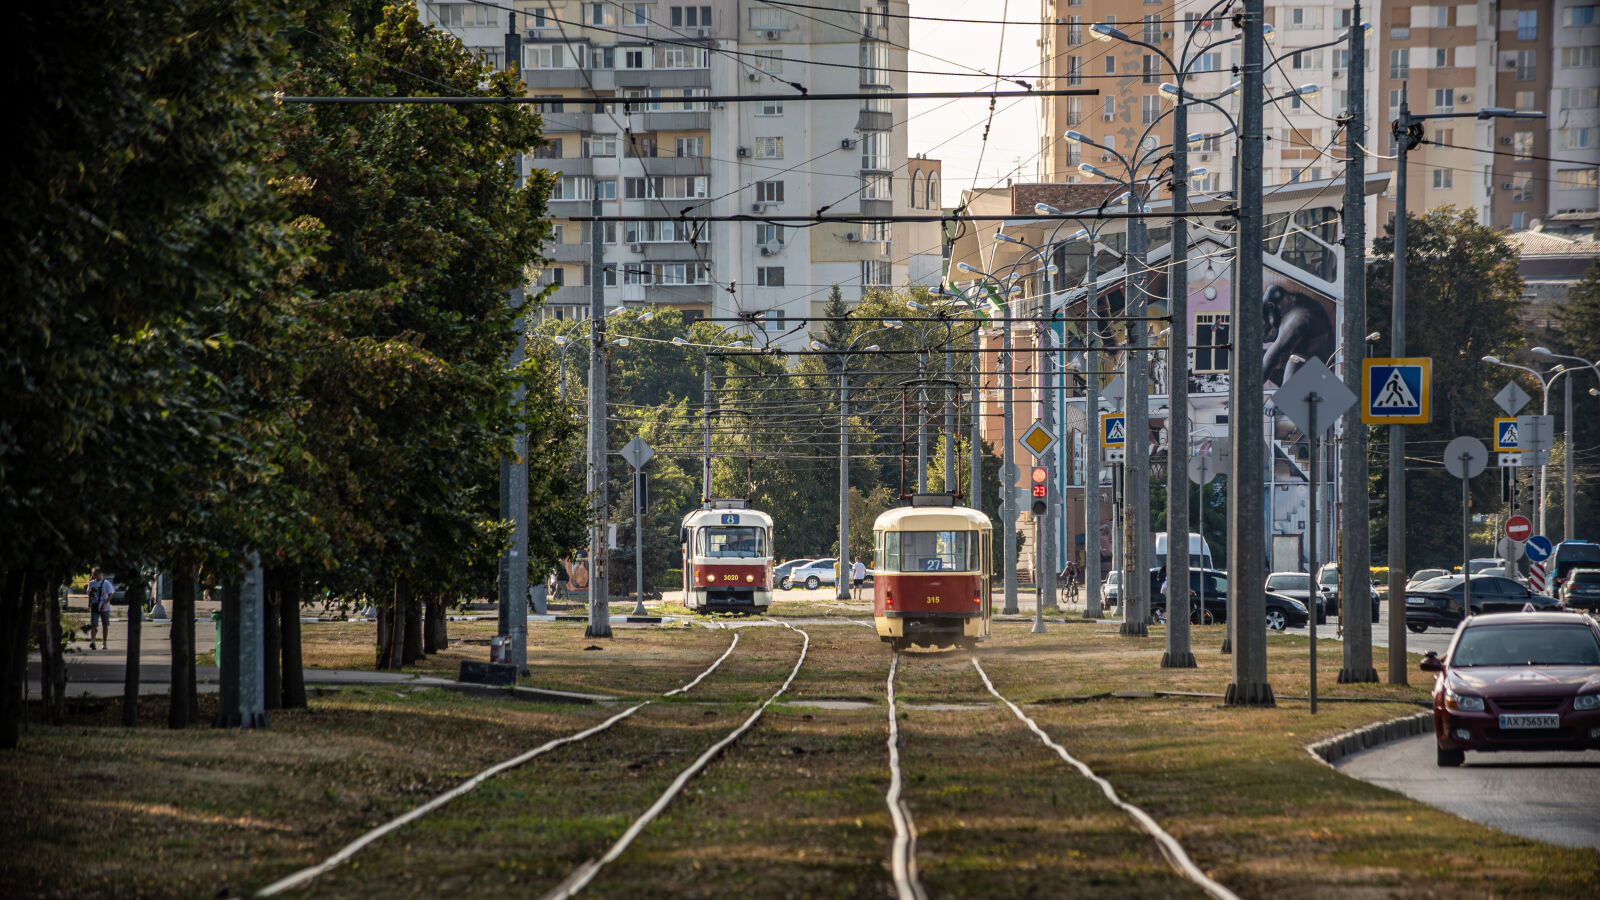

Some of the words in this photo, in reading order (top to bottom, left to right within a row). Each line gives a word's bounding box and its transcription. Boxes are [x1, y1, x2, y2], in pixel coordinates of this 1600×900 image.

[1033, 486, 1045, 496] 23
[727, 514, 734, 524] 8
[928, 560, 940, 570] 27
